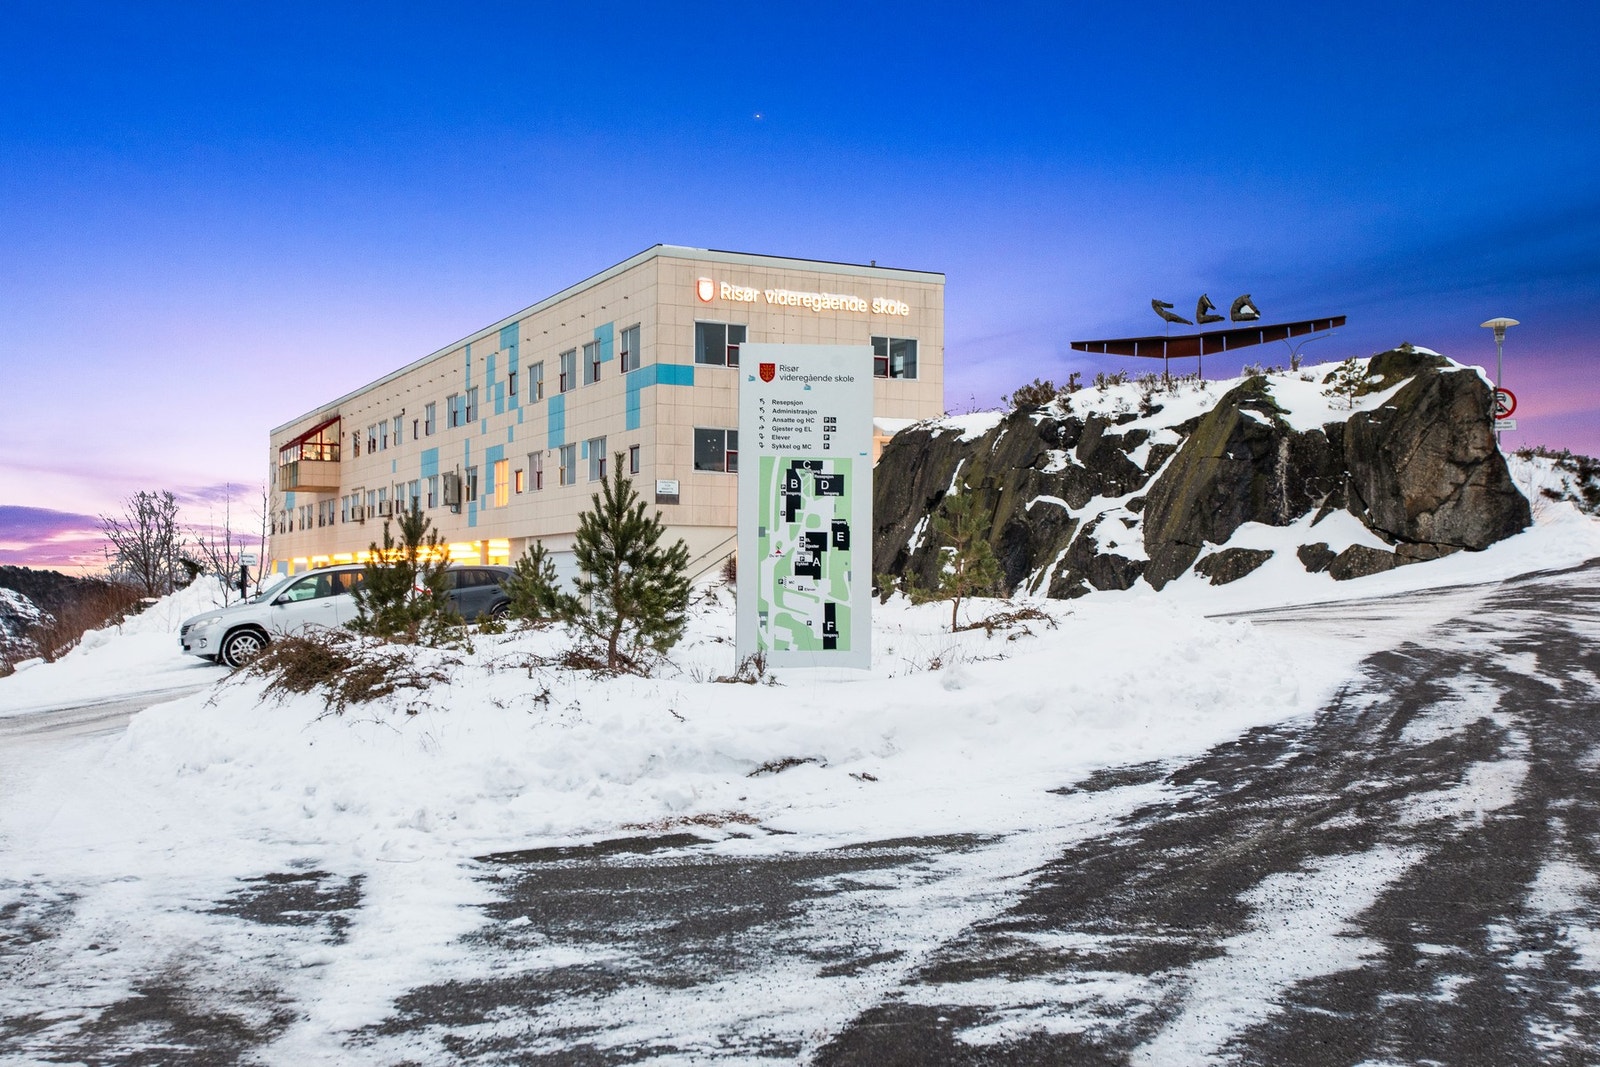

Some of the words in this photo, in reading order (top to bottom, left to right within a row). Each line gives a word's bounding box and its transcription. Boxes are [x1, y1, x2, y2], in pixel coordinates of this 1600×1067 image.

[720, 281, 760, 302] Risør
[764, 289, 868, 312] videregående
[871, 296, 909, 316] skole
[780, 374, 832, 383] videregående
[803, 460, 811, 469] C
[791, 480, 798, 488] B
[821, 481, 829, 489] D
[837, 532, 844, 541] E
[813, 557, 820, 566] A
[828, 622, 834, 630] F
